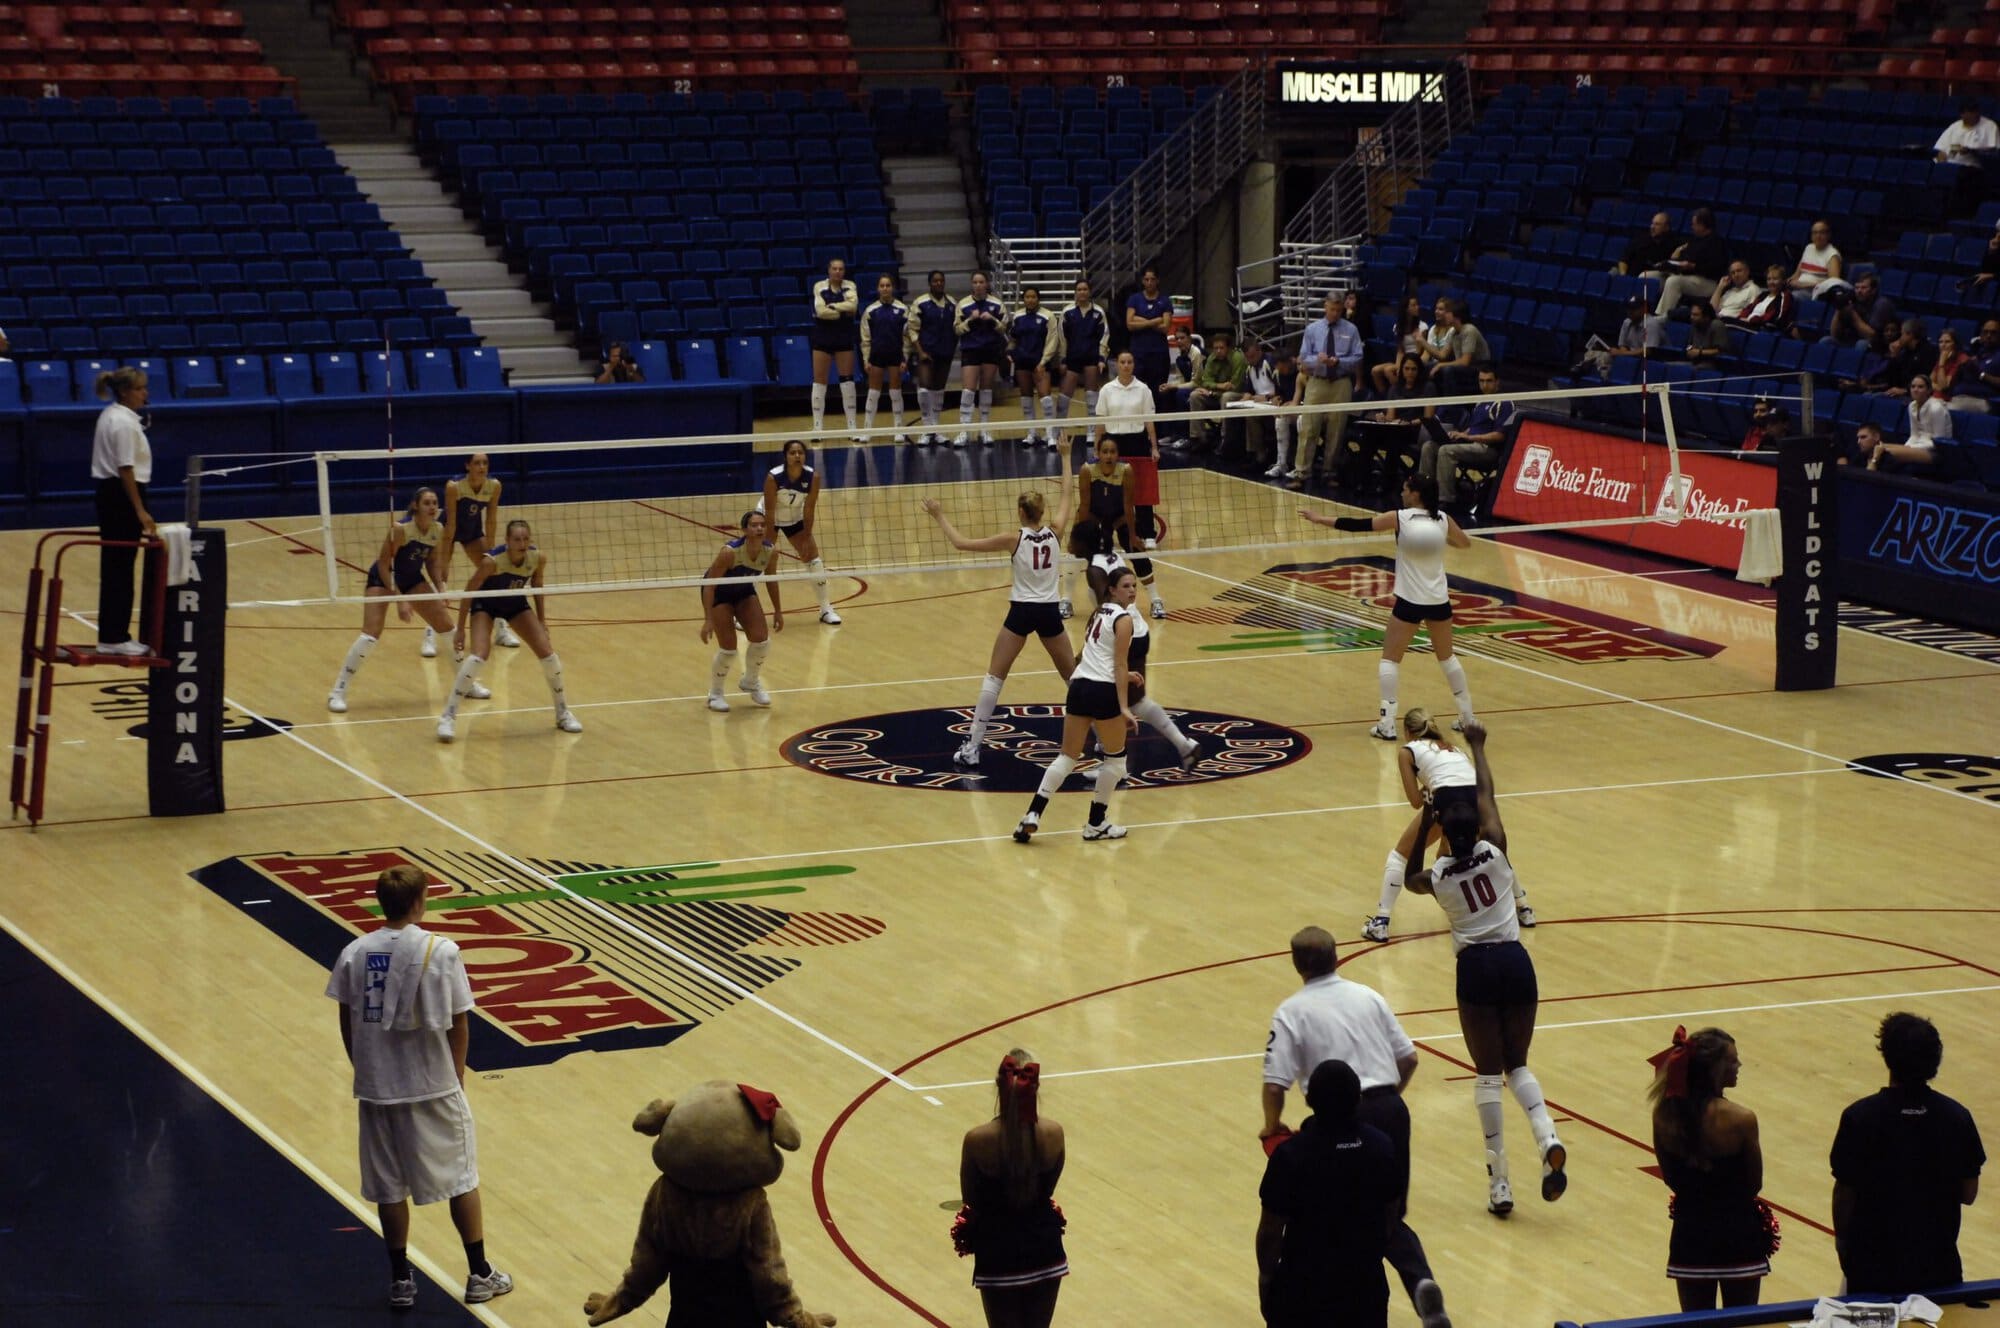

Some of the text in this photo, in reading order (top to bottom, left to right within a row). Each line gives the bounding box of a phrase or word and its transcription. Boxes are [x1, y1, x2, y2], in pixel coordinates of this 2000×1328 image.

[42, 82, 60, 98] 21
[674, 79, 692, 95] 22
[1106, 74, 1124, 89] 23
[1282, 71, 1444, 103] MUSCLE MILK
[1575, 73, 1593, 89] 24
[1544, 459, 1588, 494] State
[468, 505, 479, 517] 9
[788, 493, 797, 505] 7
[1685, 488, 1732, 524] State
[1032, 545, 1052, 570] 12
[1803, 461, 1824, 651] WILDCATS
[175, 559, 203, 764] ARIZONA
[797, 728, 989, 788] COURT
[1458, 872, 1497, 914] 10
